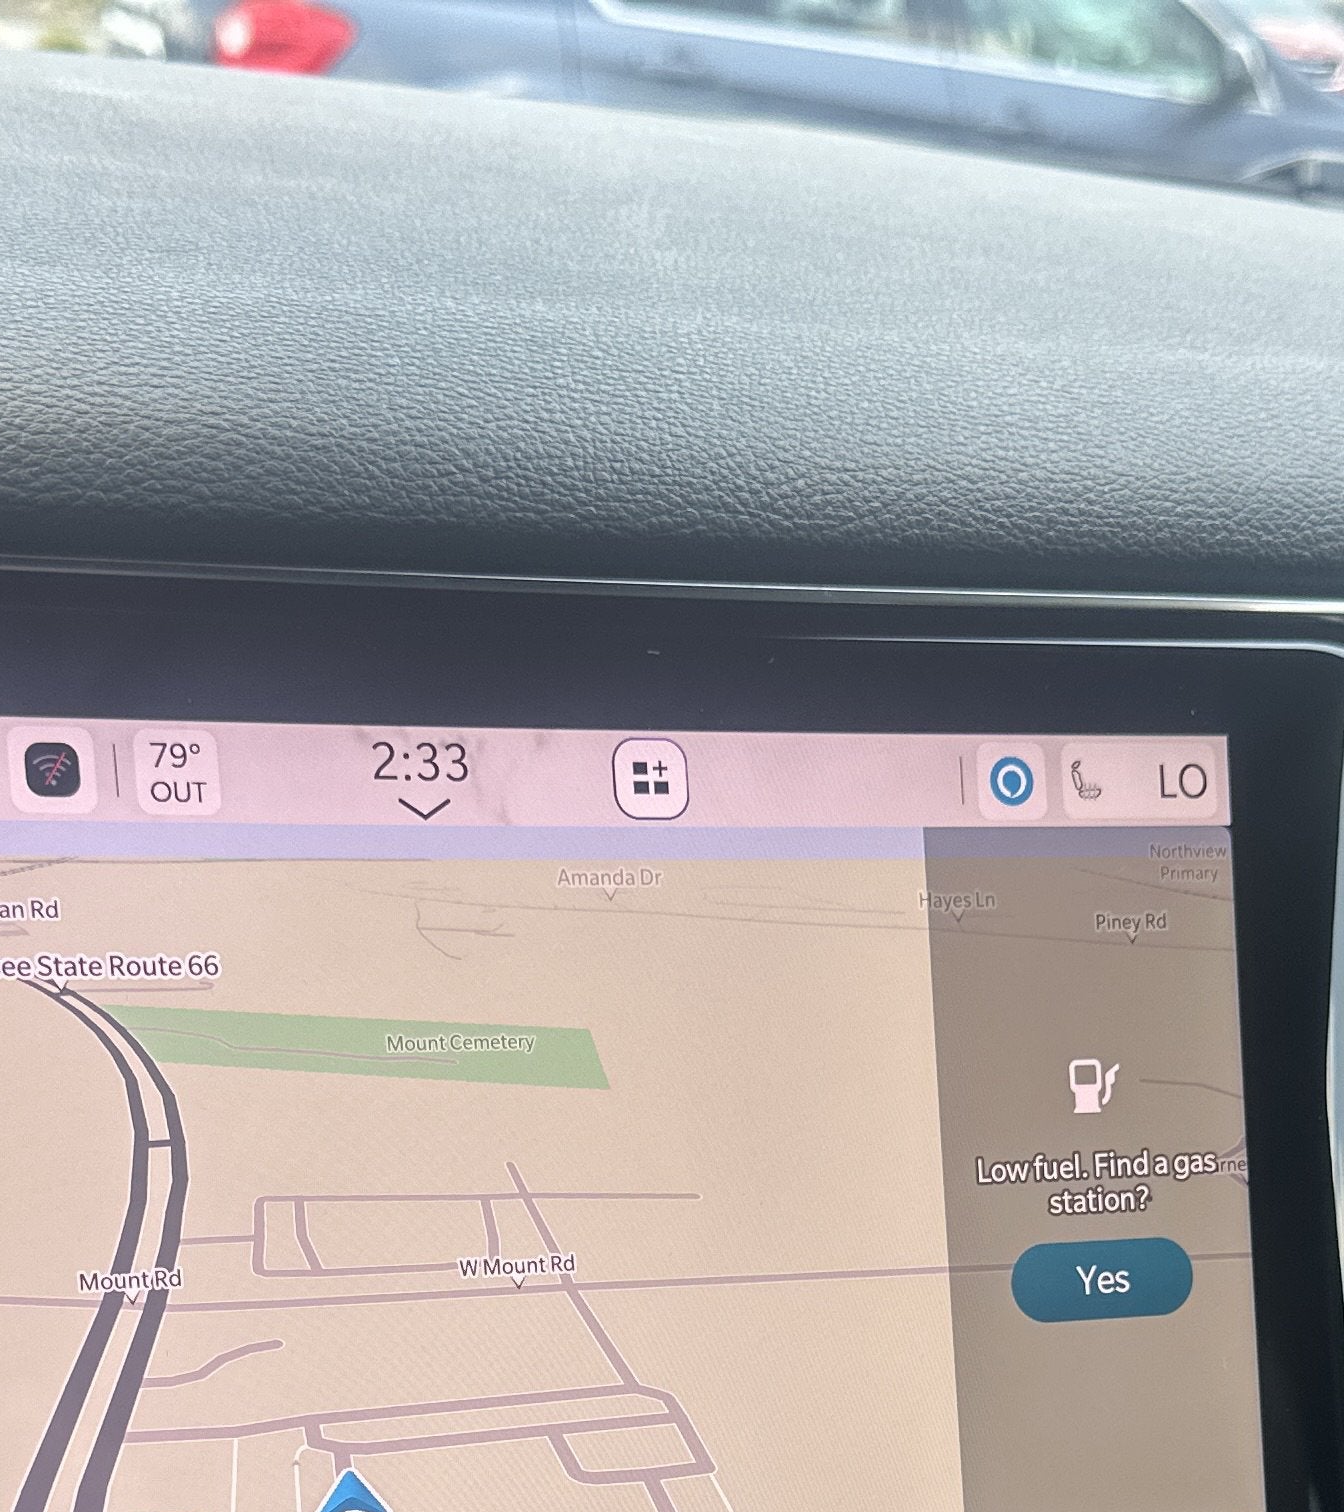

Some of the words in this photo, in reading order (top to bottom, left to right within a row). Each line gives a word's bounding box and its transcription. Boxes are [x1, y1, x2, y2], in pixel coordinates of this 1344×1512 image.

[372, 741, 469, 784] 2:33
[150, 779, 208, 805] OUT
[1158, 763, 1209, 798] LO
[1149, 843, 1227, 859] Northview
[557, 868, 636, 886] Amanda
[640, 868, 663, 886] Dr
[1160, 866, 1218, 882] Primary
[31, 899, 59, 919] Rd
[919, 892, 972, 912] Hayes
[975, 892, 996, 908] Ln
[1095, 913, 1140, 932] Piney
[1145, 912, 1167, 930] Rd
[37, 954, 104, 978] State
[109, 954, 183, 977] Route
[188, 954, 220, 977] 66
[386, 1034, 446, 1053] Mount
[450, 1033, 536, 1054] Cemetery
[977, 1156, 1030, 1184] Low
[1033, 1153, 1089, 1181] fuel.
[1093, 1149, 1149, 1178] Find
[1154, 1156, 1169, 1176] a
[1173, 1152, 1217, 1180] gas
[1049, 1185, 1151, 1215] station?
[459, 1258, 479, 1276] W
[482, 1256, 545, 1276] Mount
[547, 1254, 576, 1274] Rd
[79, 1268, 148, 1294] Mount
[151, 1267, 183, 1291] Rd
[1075, 1264, 1131, 1296] Yes
